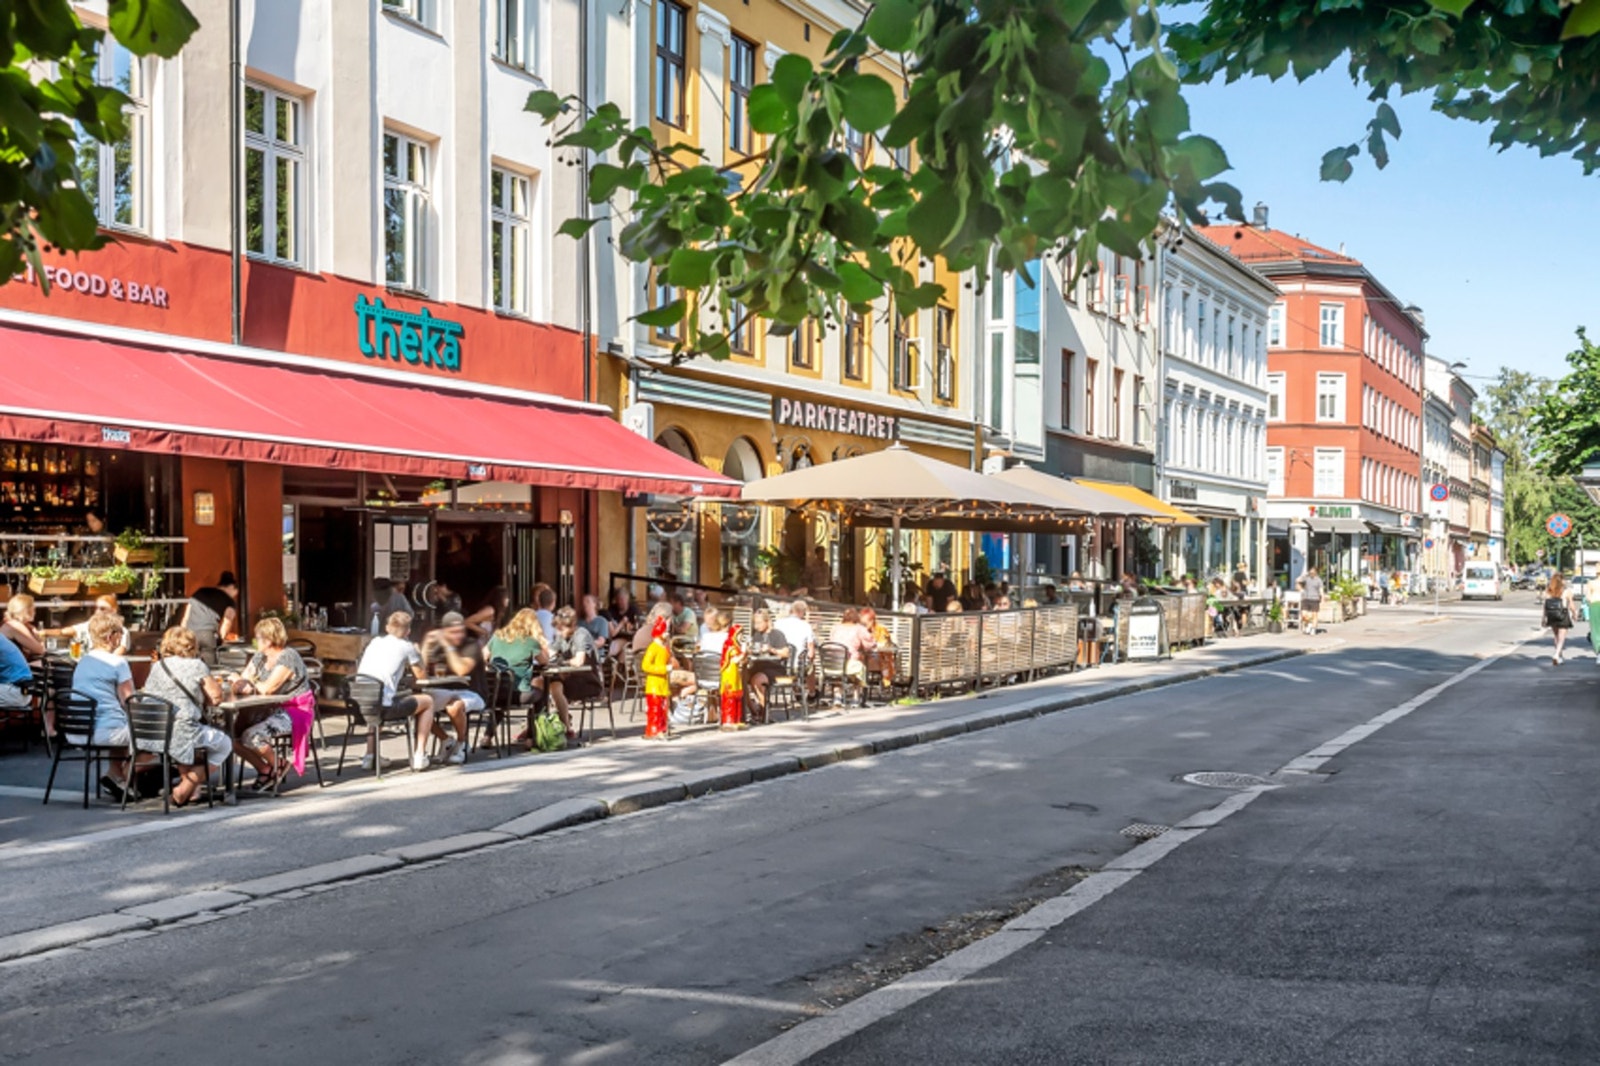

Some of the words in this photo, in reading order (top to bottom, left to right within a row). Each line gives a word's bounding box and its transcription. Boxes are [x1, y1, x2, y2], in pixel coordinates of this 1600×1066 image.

[43, 264, 106, 295] FOOD
[109, 278, 124, 299] &
[127, 281, 167, 307] BAR
[354, 293, 462, 369] theka
[779, 398, 895, 439] PARKTEATRET
